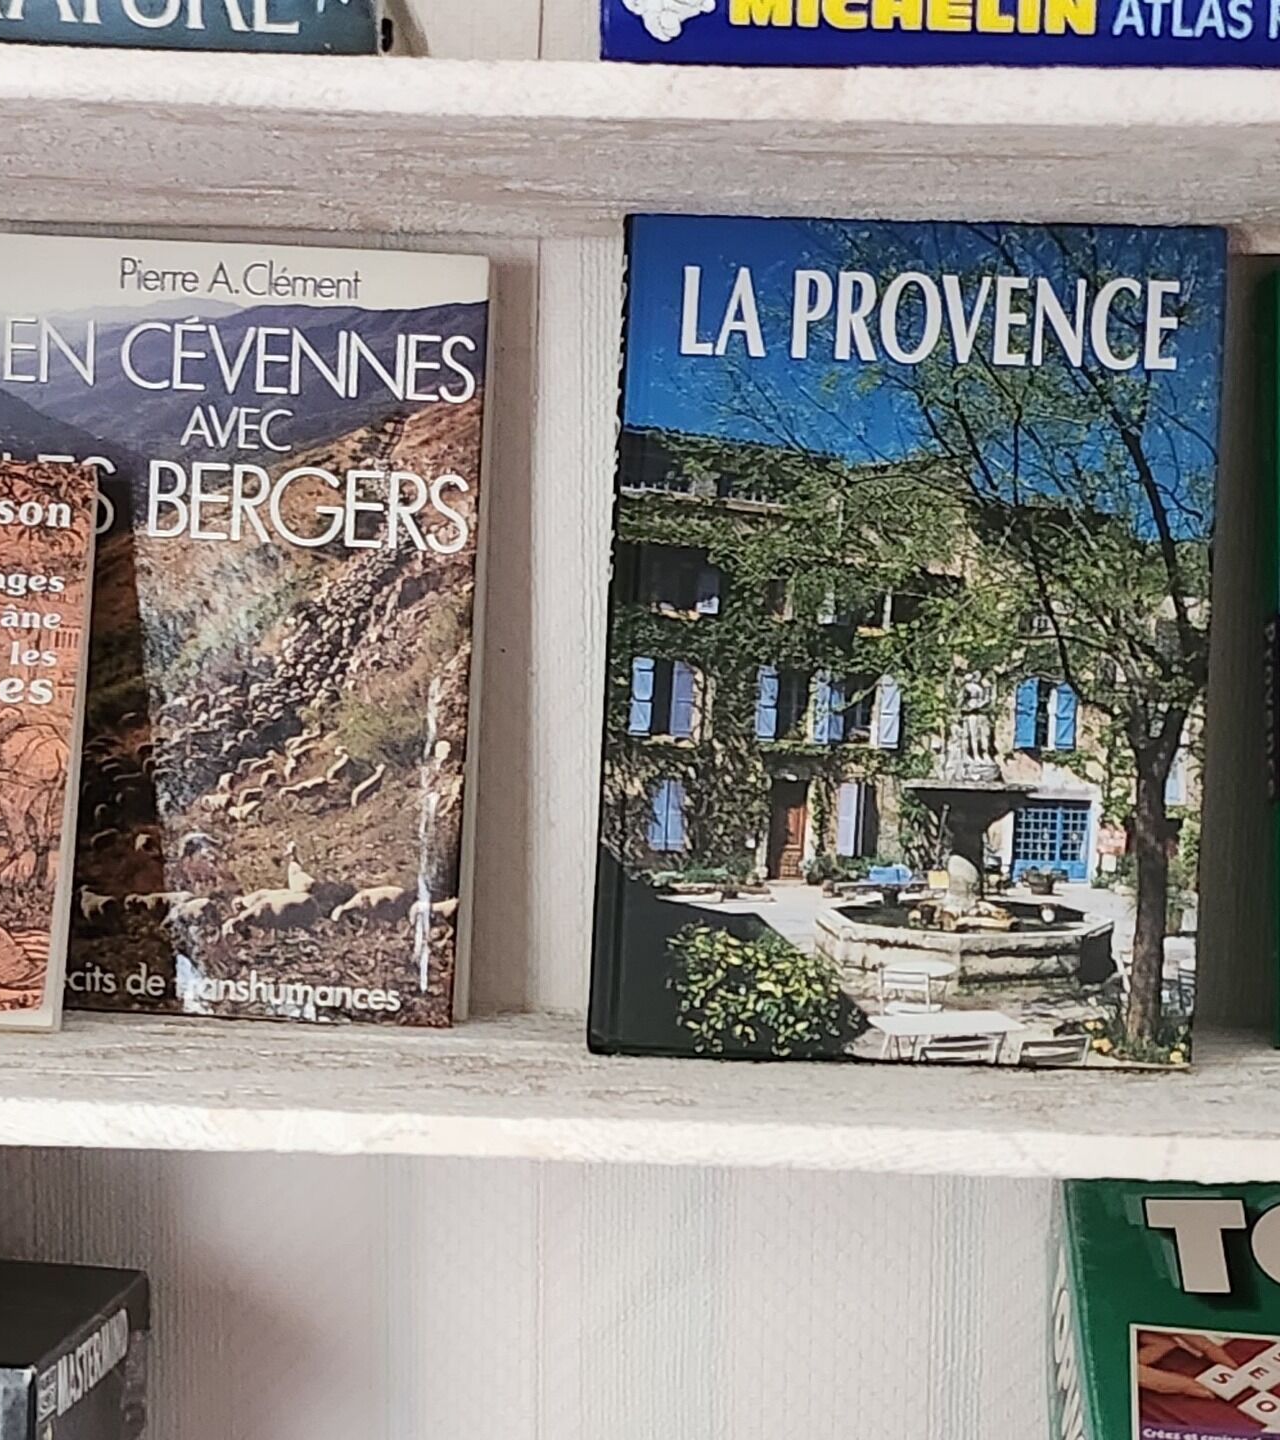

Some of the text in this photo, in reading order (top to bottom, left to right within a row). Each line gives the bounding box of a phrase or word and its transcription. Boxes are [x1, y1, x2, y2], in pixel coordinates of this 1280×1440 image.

[728, 0, 1097, 36] MICHELIN
[1113, 0, 1253, 39] ATLAS
[120, 257, 199, 293] Pierre
[681, 265, 1182, 374] LA PROVENCE
[3, 315, 477, 404] EN CÉVENNES
[180, 405, 294, 452] AVEC
[148, 460, 472, 555] BERGERS
[0, 605, 62, 630] âne
[9, 640, 58, 667] les
[126, 962, 167, 997] de
